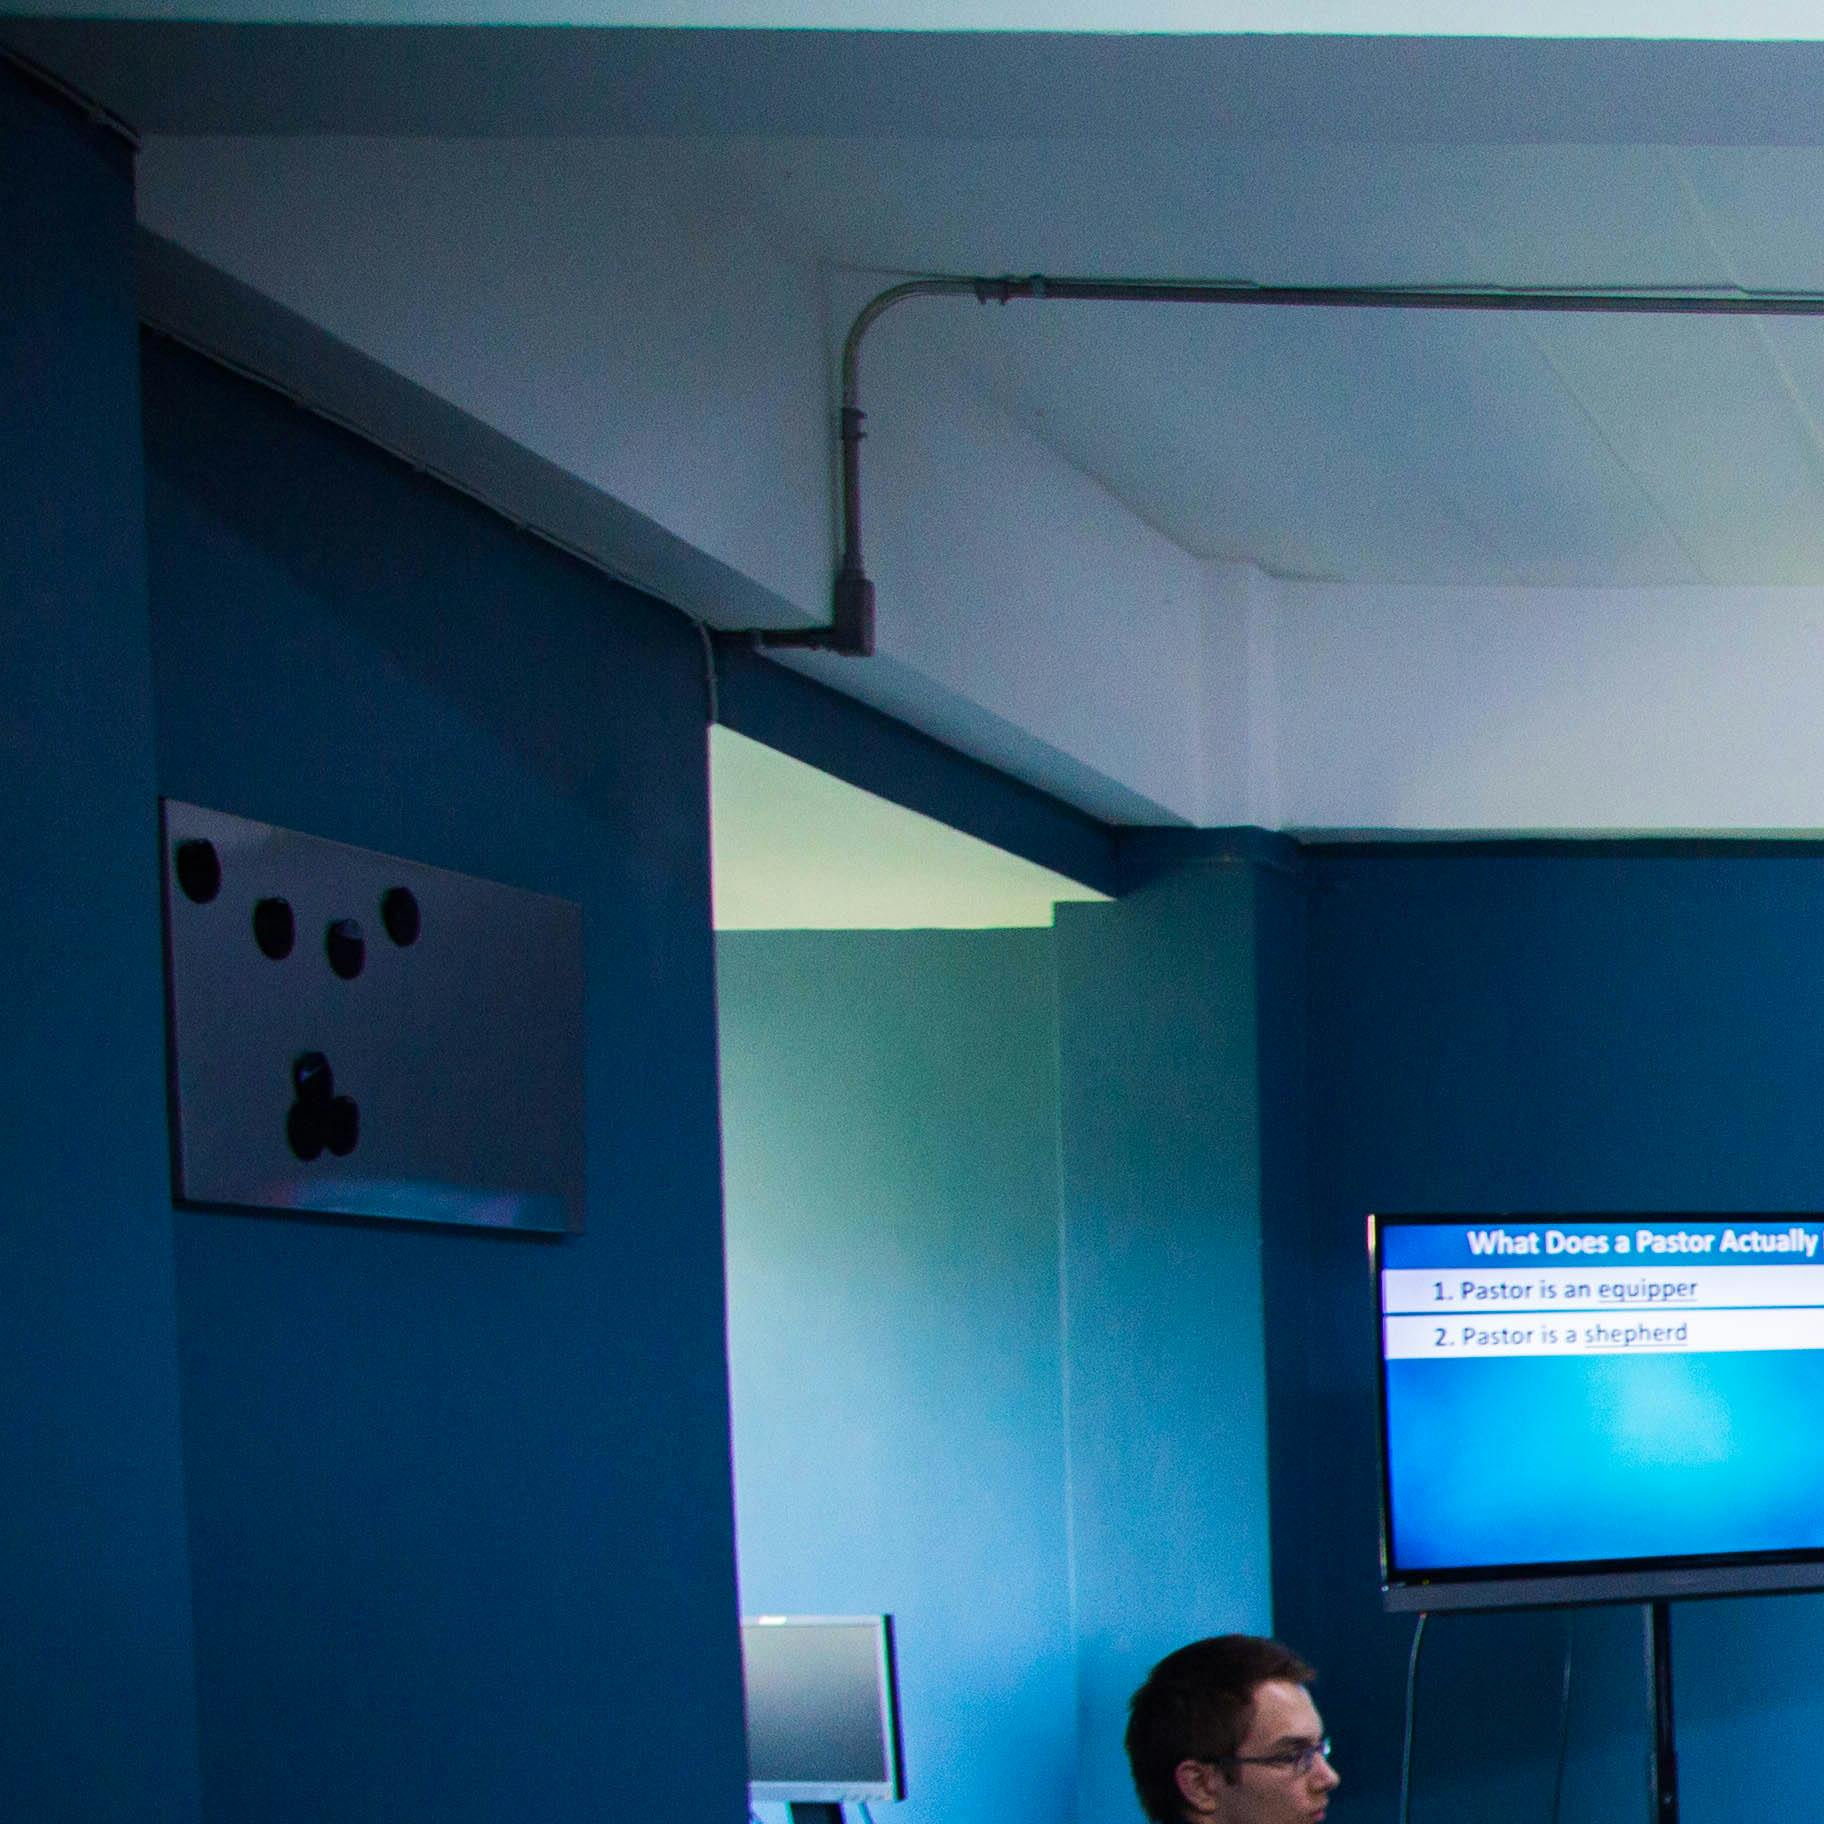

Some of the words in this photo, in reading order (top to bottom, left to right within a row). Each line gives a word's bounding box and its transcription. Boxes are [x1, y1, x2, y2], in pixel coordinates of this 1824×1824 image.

[1466, 1229, 1540, 1256] What
[1545, 1229, 1609, 1255] Does
[1613, 1234, 1630, 1254] a
[1635, 1228, 1716, 1254] Pastor
[1718, 1227, 1819, 1258] Actually
[1432, 1281, 1454, 1302] 1.
[1460, 1280, 1534, 1300] Pastor
[1539, 1278, 1557, 1299] is
[1563, 1282, 1591, 1298] an
[1598, 1276, 1698, 1303] equipper
[1433, 1327, 1456, 1347] 2.
[1462, 1326, 1535, 1346] Pastor
[1541, 1324, 1559, 1344] is
[1565, 1328, 1578, 1345] a
[1584, 1321, 1689, 1347] shepherd
